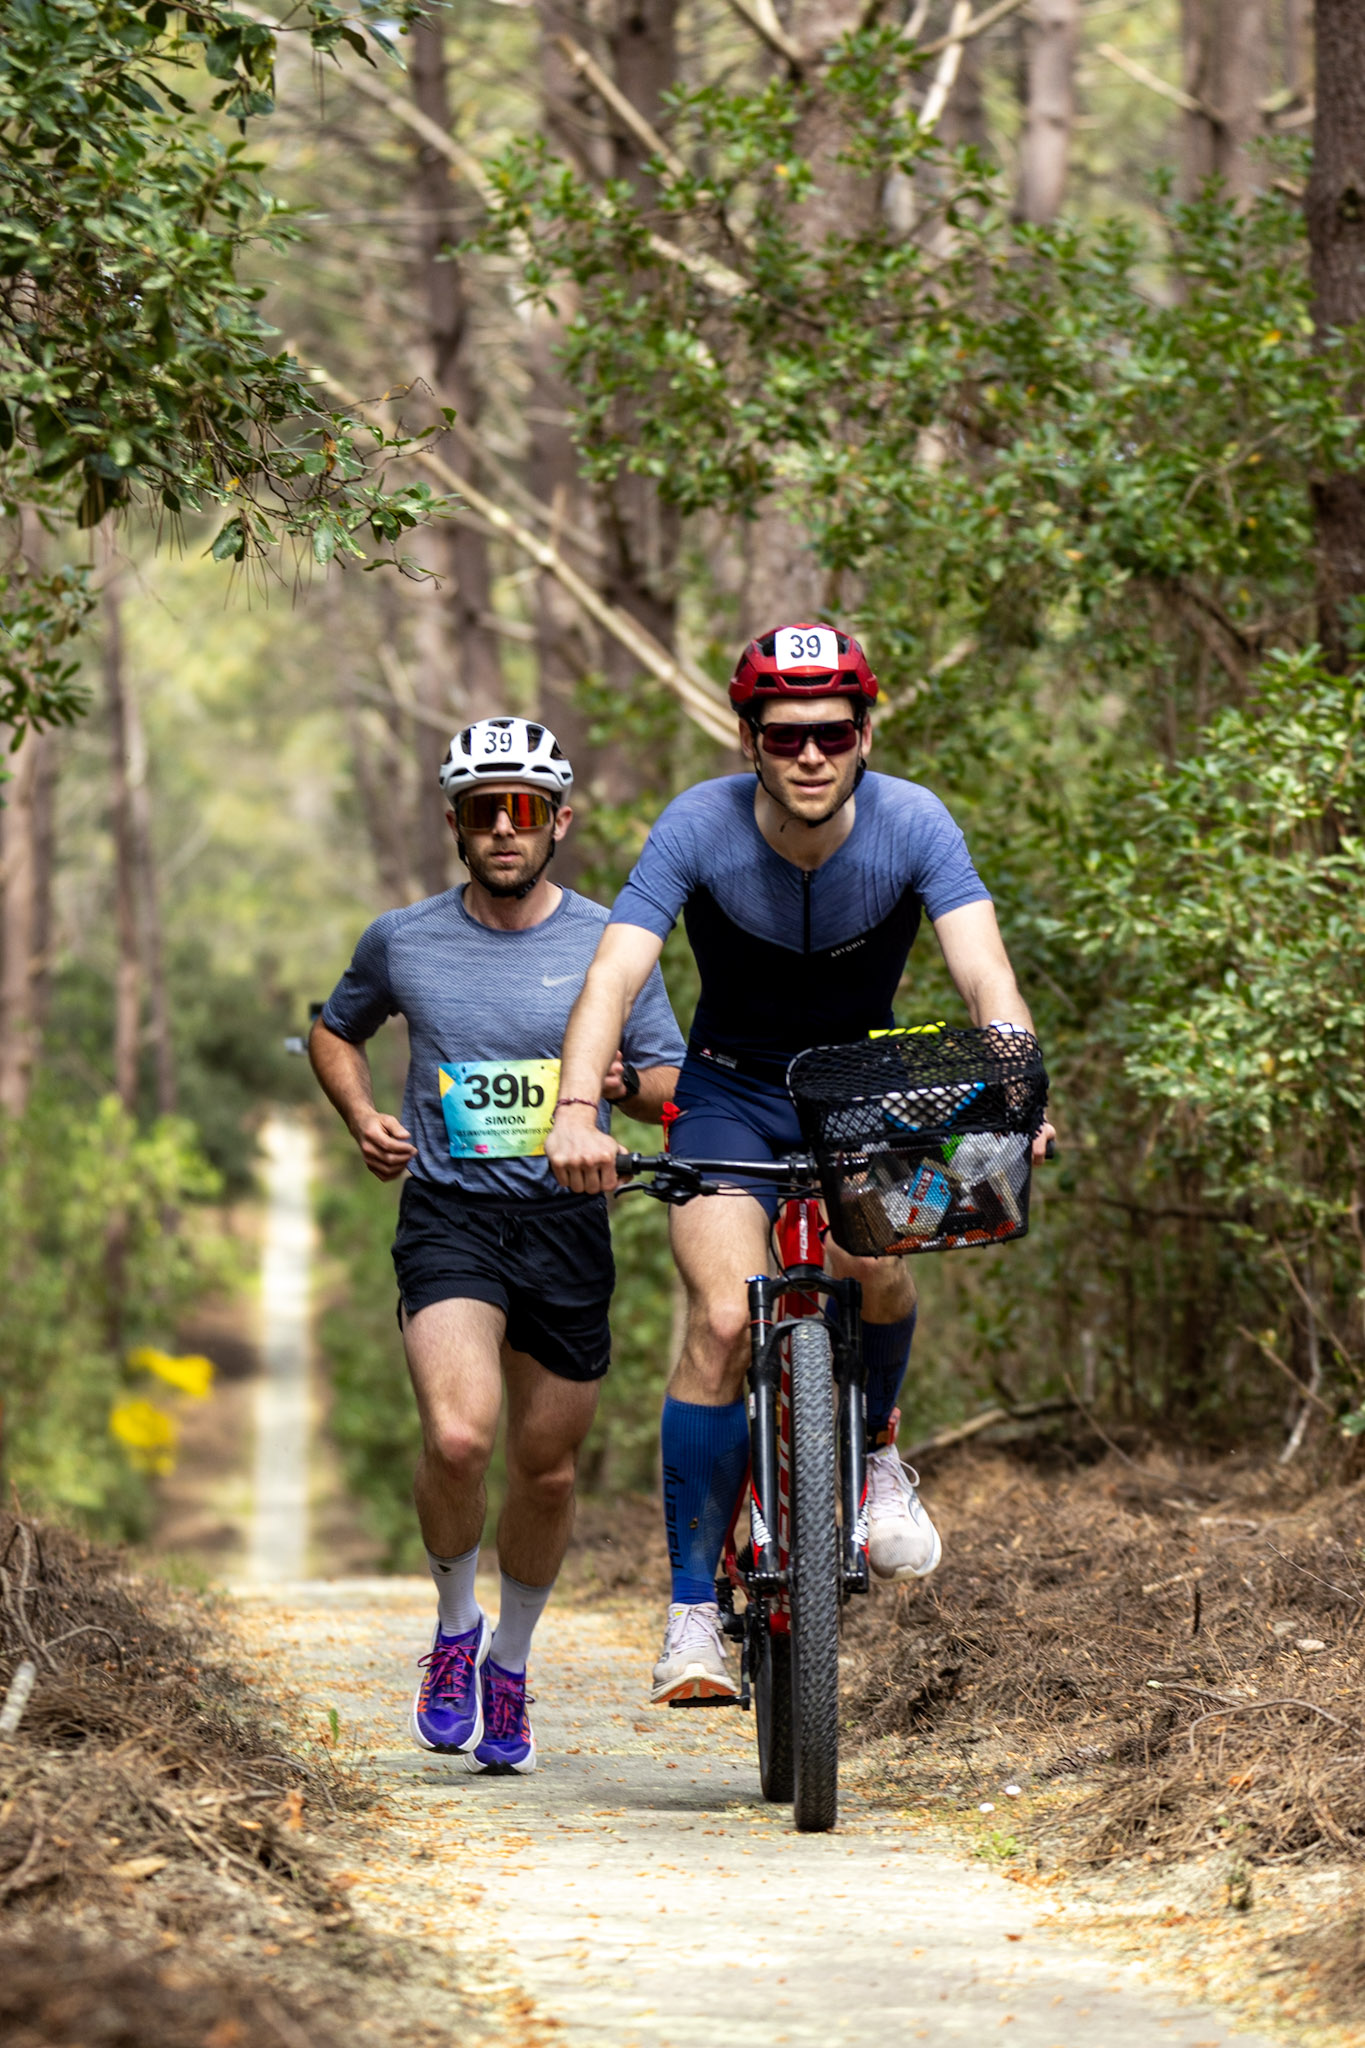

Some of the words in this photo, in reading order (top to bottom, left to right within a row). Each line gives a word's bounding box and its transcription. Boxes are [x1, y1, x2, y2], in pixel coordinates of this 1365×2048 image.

[790, 634, 822, 659] 39
[484, 731, 513, 754] 39
[463, 1073, 545, 1110] 39b
[484, 1115, 526, 1126] SIMON
[798, 1203, 809, 1261] FOCUS
